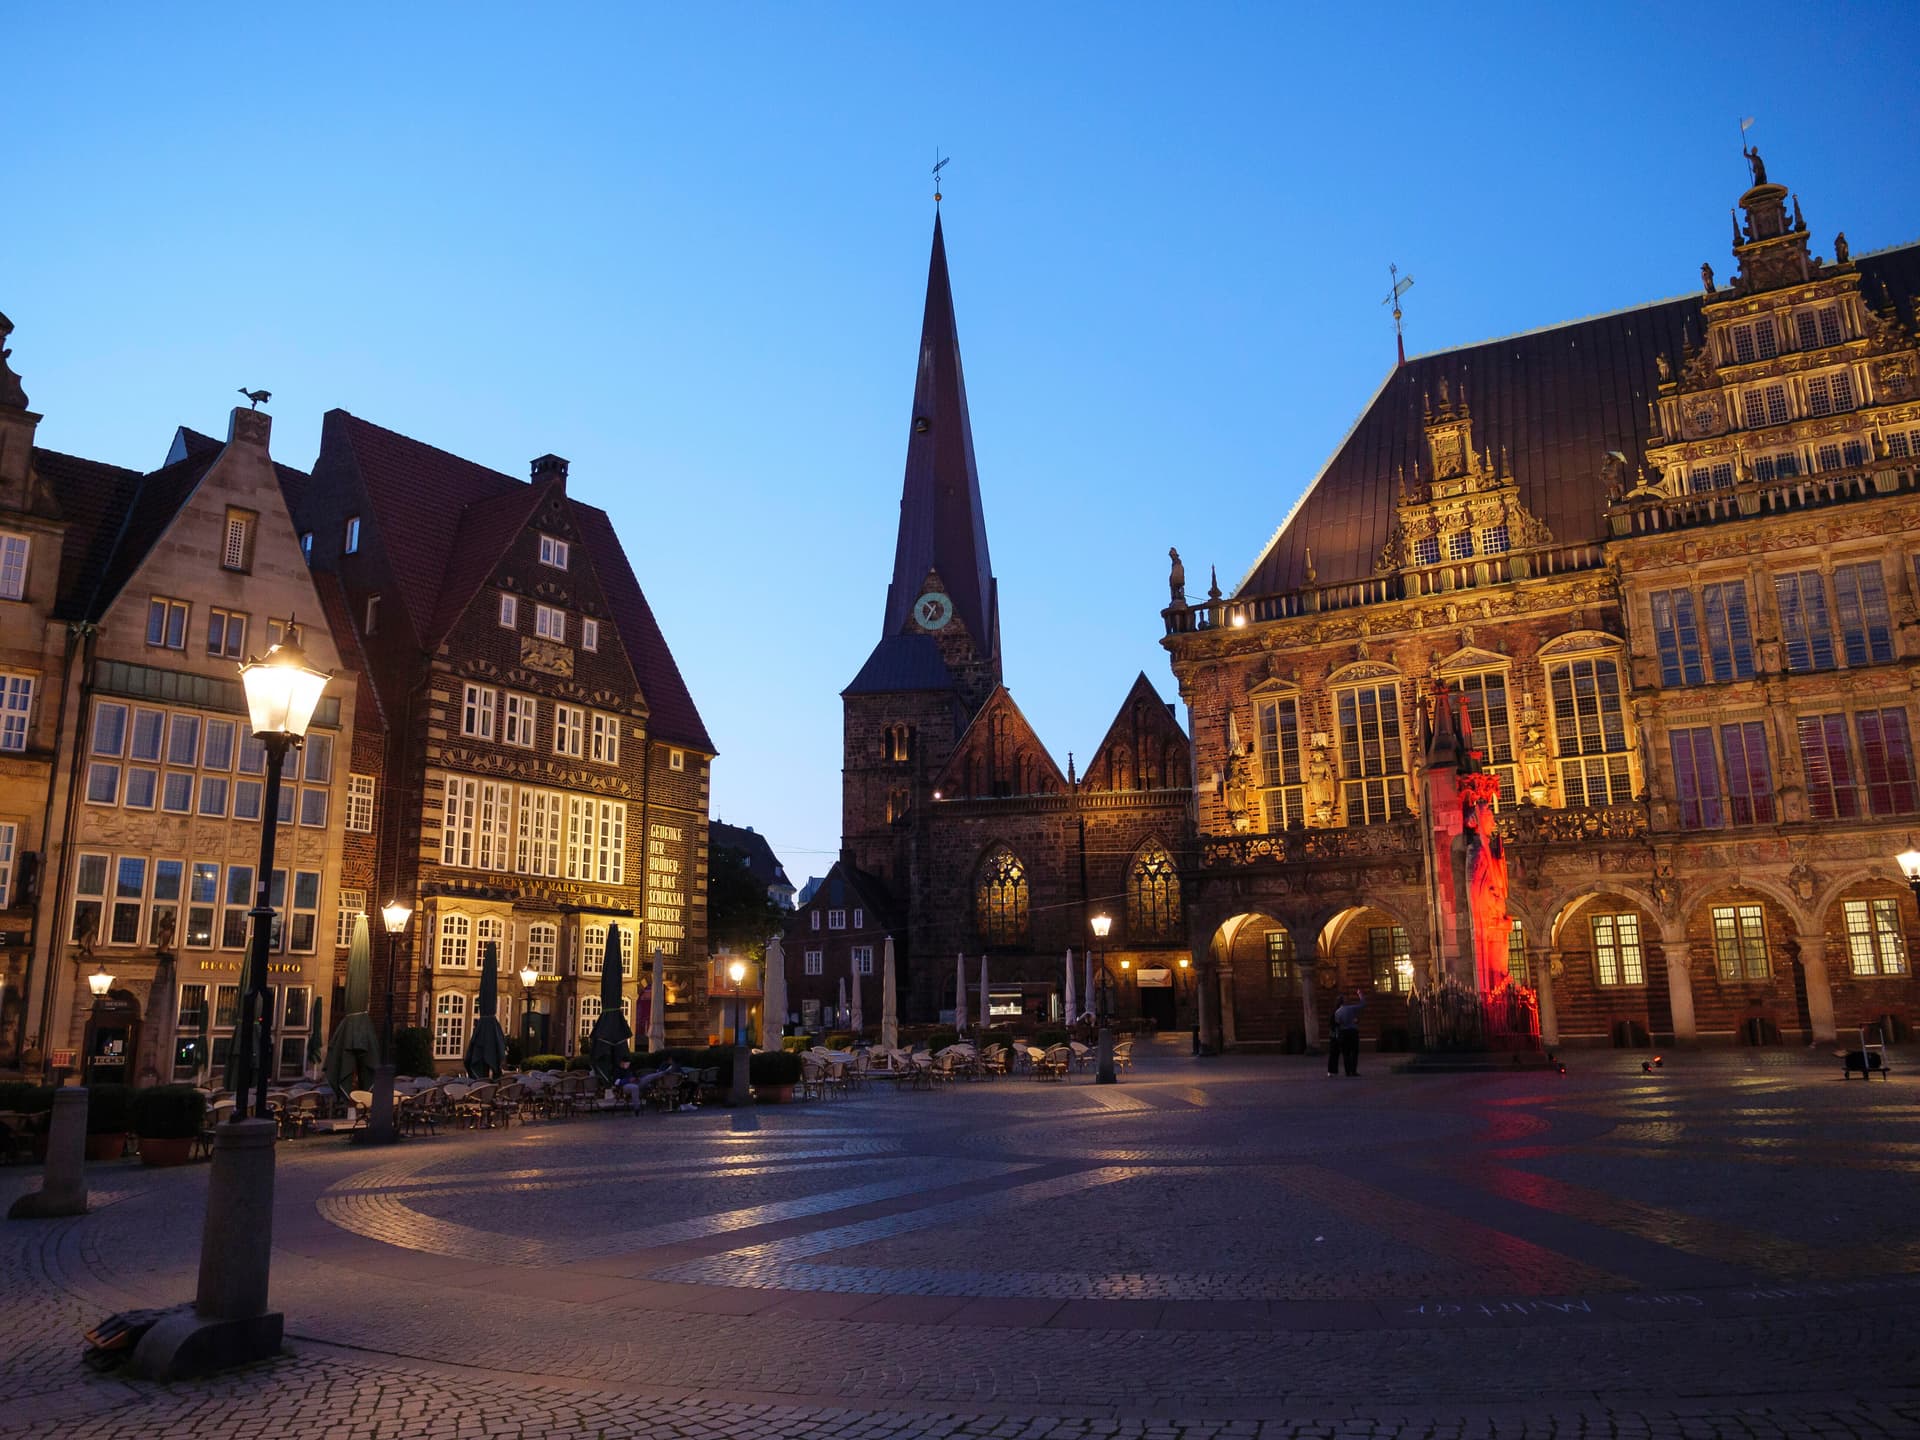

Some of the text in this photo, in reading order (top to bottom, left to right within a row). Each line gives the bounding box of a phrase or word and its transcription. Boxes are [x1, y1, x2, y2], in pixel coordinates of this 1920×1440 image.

[650, 824, 682, 841] GEDENKE
[650, 841, 665, 855] DER
[527, 879, 544, 889] AM
[547, 880, 584, 894] MARKT
[649, 873, 676, 889] DIE DAS
[648, 890, 685, 906] SCHICKSAL
[648, 906, 680, 922] UNSERER
[647, 923, 685, 939] TRENNUNG
